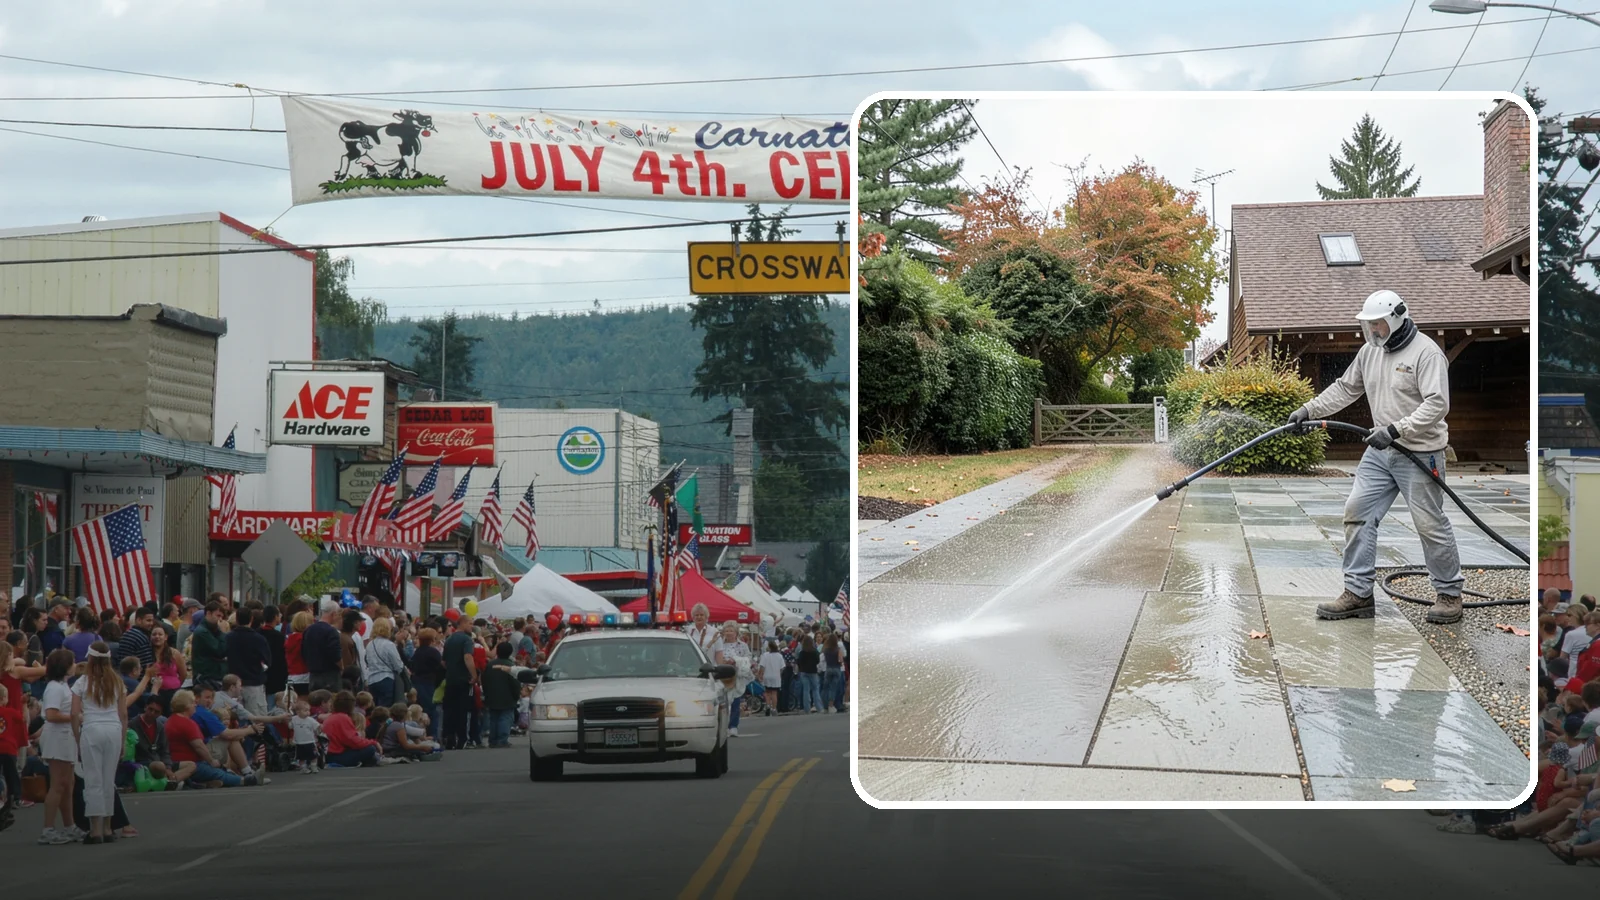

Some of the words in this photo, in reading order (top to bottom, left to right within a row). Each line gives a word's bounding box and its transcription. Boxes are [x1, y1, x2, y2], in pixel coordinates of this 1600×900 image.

[695, 121, 850, 150] Carnat
[481, 141, 604, 193] JULY
[632, 150, 746, 198] 4th.
[697, 254, 850, 280] CROSSWA
[282, 380, 373, 420] ACE
[406, 409, 453, 422] CEDAR
[461, 409, 485, 421] LOG
[283, 421, 371, 436] Hardware
[416, 428, 477, 447] Coca-Cola
[353, 467, 385, 481] Simpl
[95, 485, 125, 495] Vincent
[126, 486, 135, 494] de
[137, 486, 155, 496] Paul
[212, 516, 331, 536] HARDARE
[688, 526, 741, 536] CRNATION
[699, 535, 730, 544] GLASS
